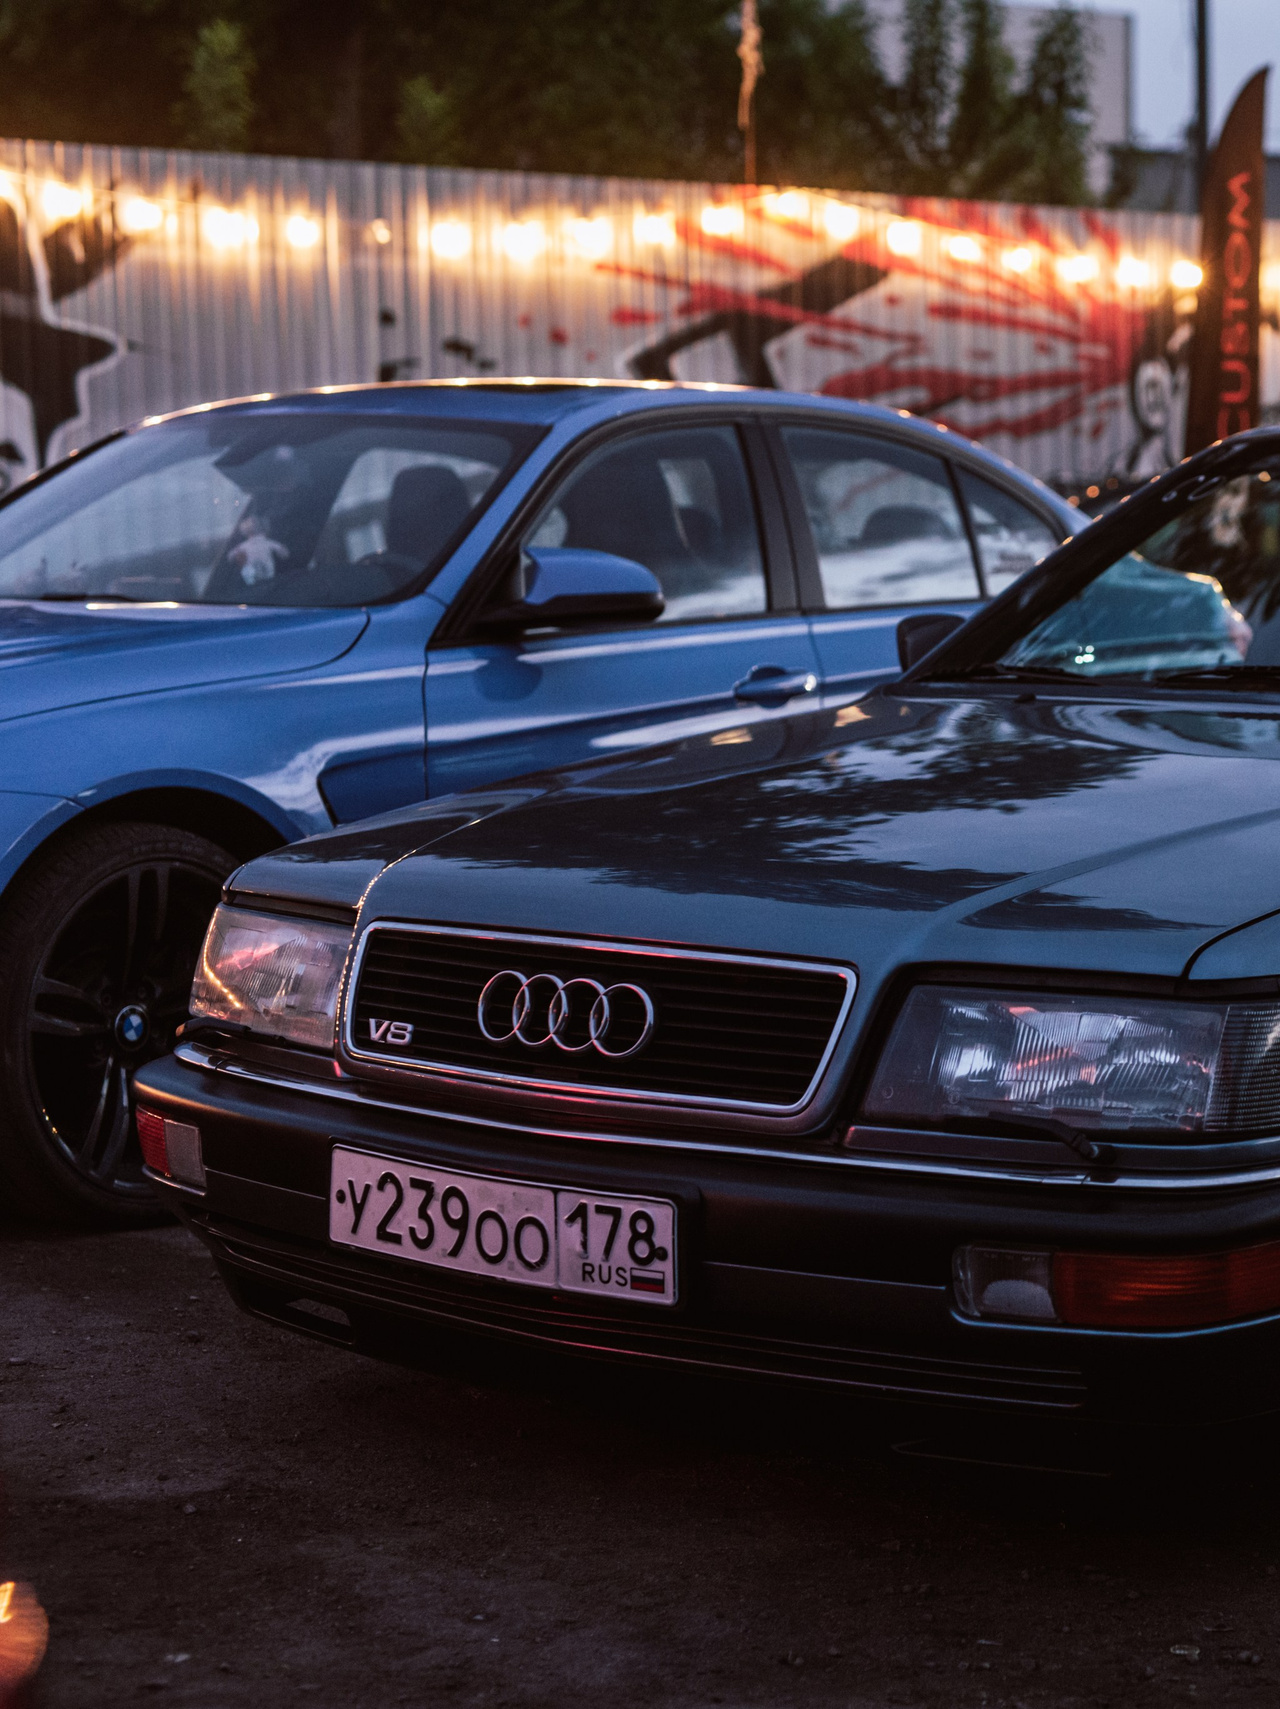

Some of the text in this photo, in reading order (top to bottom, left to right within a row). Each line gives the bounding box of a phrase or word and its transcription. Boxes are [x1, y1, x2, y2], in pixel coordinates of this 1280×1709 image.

[1216, 171, 1252, 440] CUSTOM
[369, 1018, 414, 1045] V8
[564, 1200, 656, 1266] 178
[582, 1262, 628, 1287] RUS
